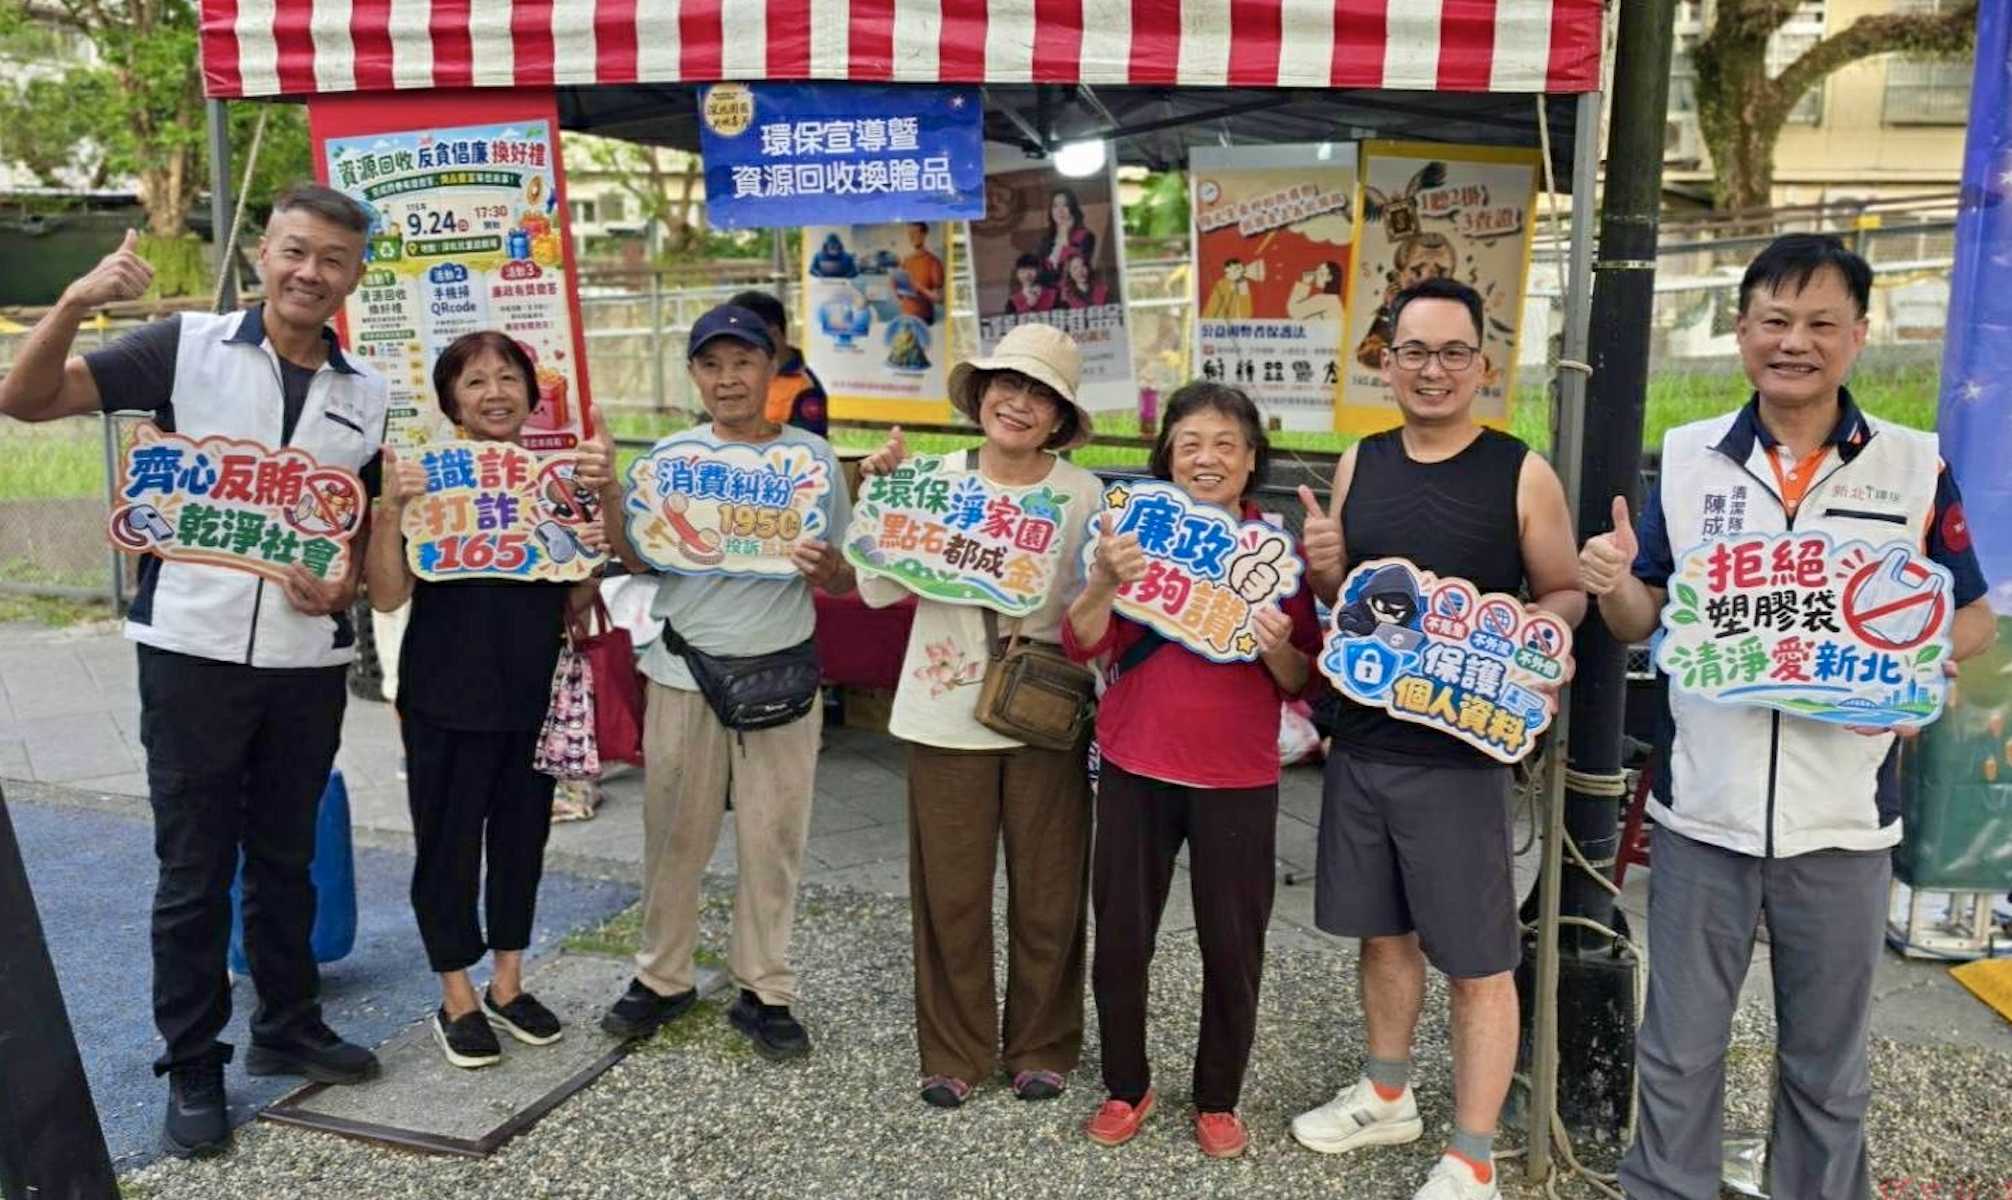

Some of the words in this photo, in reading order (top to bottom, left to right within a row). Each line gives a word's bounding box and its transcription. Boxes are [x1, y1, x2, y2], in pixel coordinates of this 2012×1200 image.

[760, 116, 920, 157] 環保宣導暨
[337, 151, 414, 188] 資源回收
[417, 140, 489, 168] 反貪倡廉
[492, 141, 547, 167] 換好禮
[732, 157, 952, 199] 資源回收換贈品
[407, 211, 456, 236] 9.24
[475, 205, 508, 218] 17:30
[435, 267, 463, 282] 活動2
[431, 303, 477, 317] QRcode
[125, 446, 308, 506] 齊心反賄
[421, 448, 528, 493] 識詐
[660, 460, 794, 507] 消費糾紛
[424, 492, 519, 536] 打詐
[717, 504, 800, 541] 1950
[867, 468, 1055, 554] 環保淨家園
[1702, 494, 1727, 542] 陳成
[177, 502, 341, 578] 乾淨社會
[435, 533, 528, 571] 165
[879, 513, 1043, 594] 點石都成金
[1116, 496, 1236, 575] 廉政
[1708, 540, 1828, 592] 拒絕
[1118, 561, 1250, 649] 夠讚
[1706, 590, 1841, 639] 塑膠袋
[1425, 643, 1504, 698] 保護
[1668, 635, 1902, 687] 清淨愛新北
[1393, 677, 1526, 752] 個人資料
